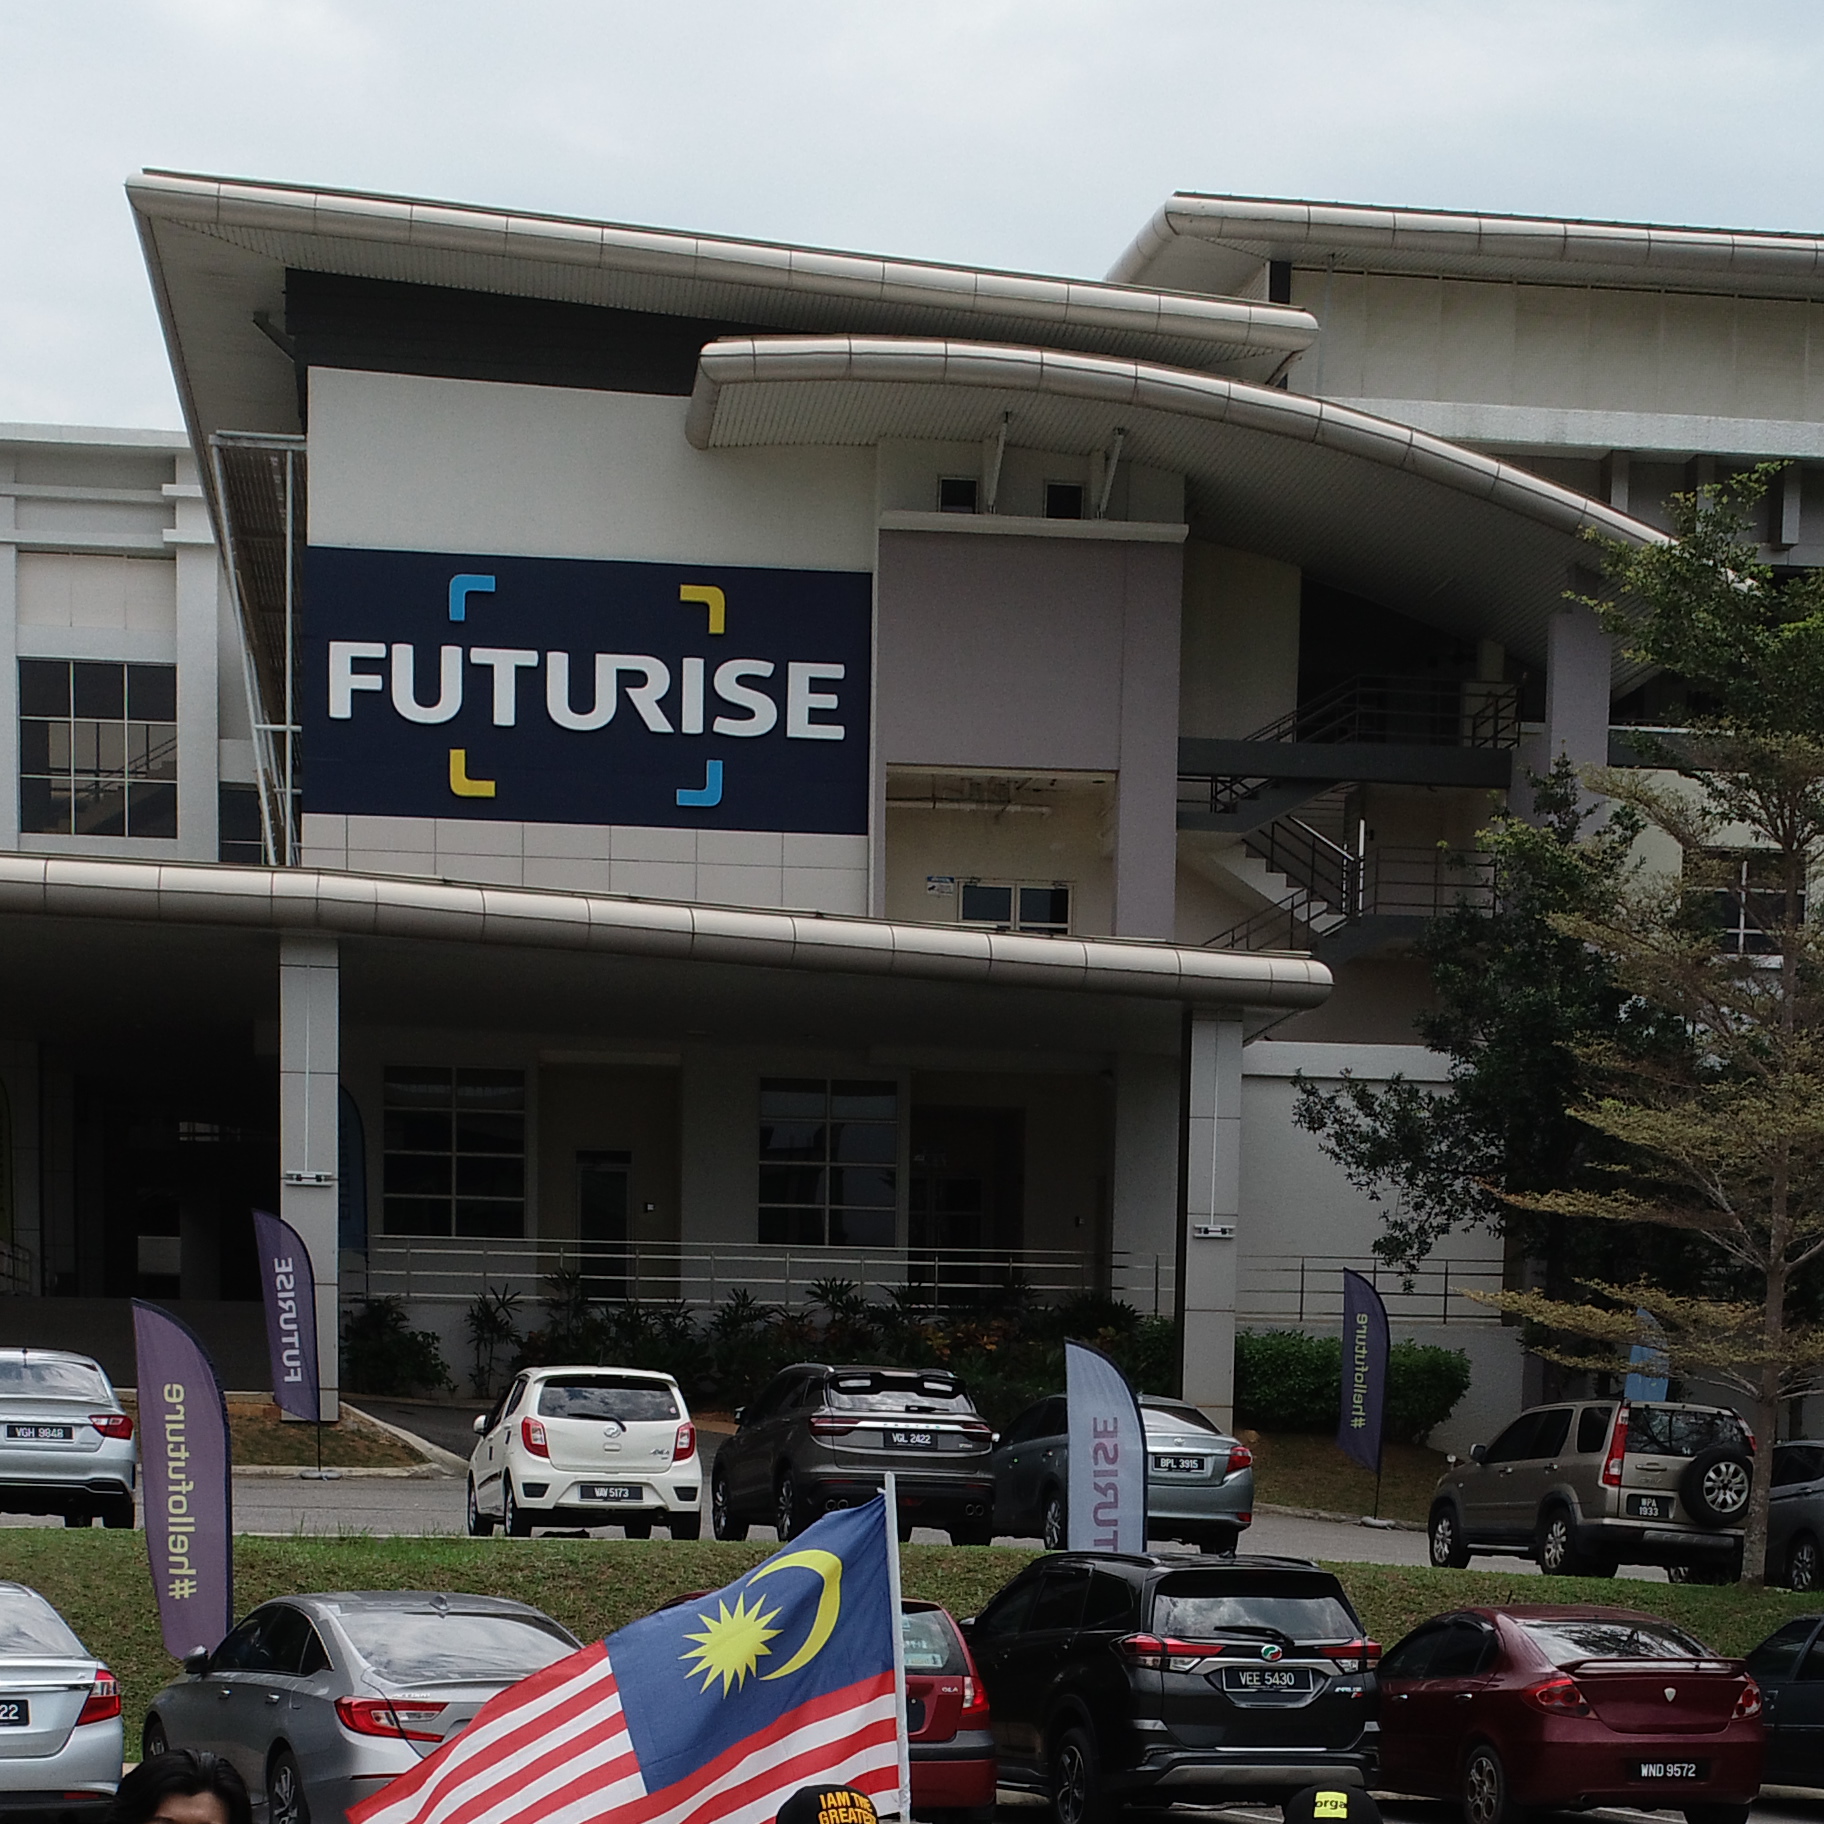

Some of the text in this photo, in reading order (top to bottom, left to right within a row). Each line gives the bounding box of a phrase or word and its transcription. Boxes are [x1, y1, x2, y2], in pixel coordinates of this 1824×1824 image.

[327, 640, 848, 742] FUTURISE
[15, 1426, 64, 1438] VGH 9848
[892, 1433, 931, 1444] VGL 2422
[1160, 1458, 1198, 1470] BPL 3915
[609, 1487, 630, 1498] 5173
[1639, 1506, 1659, 1516] 1933
[1239, 1671, 1294, 1686] VEE 5430
[1640, 1763, 1697, 1777] WND 9572
[850, 1792, 873, 1812] THE
